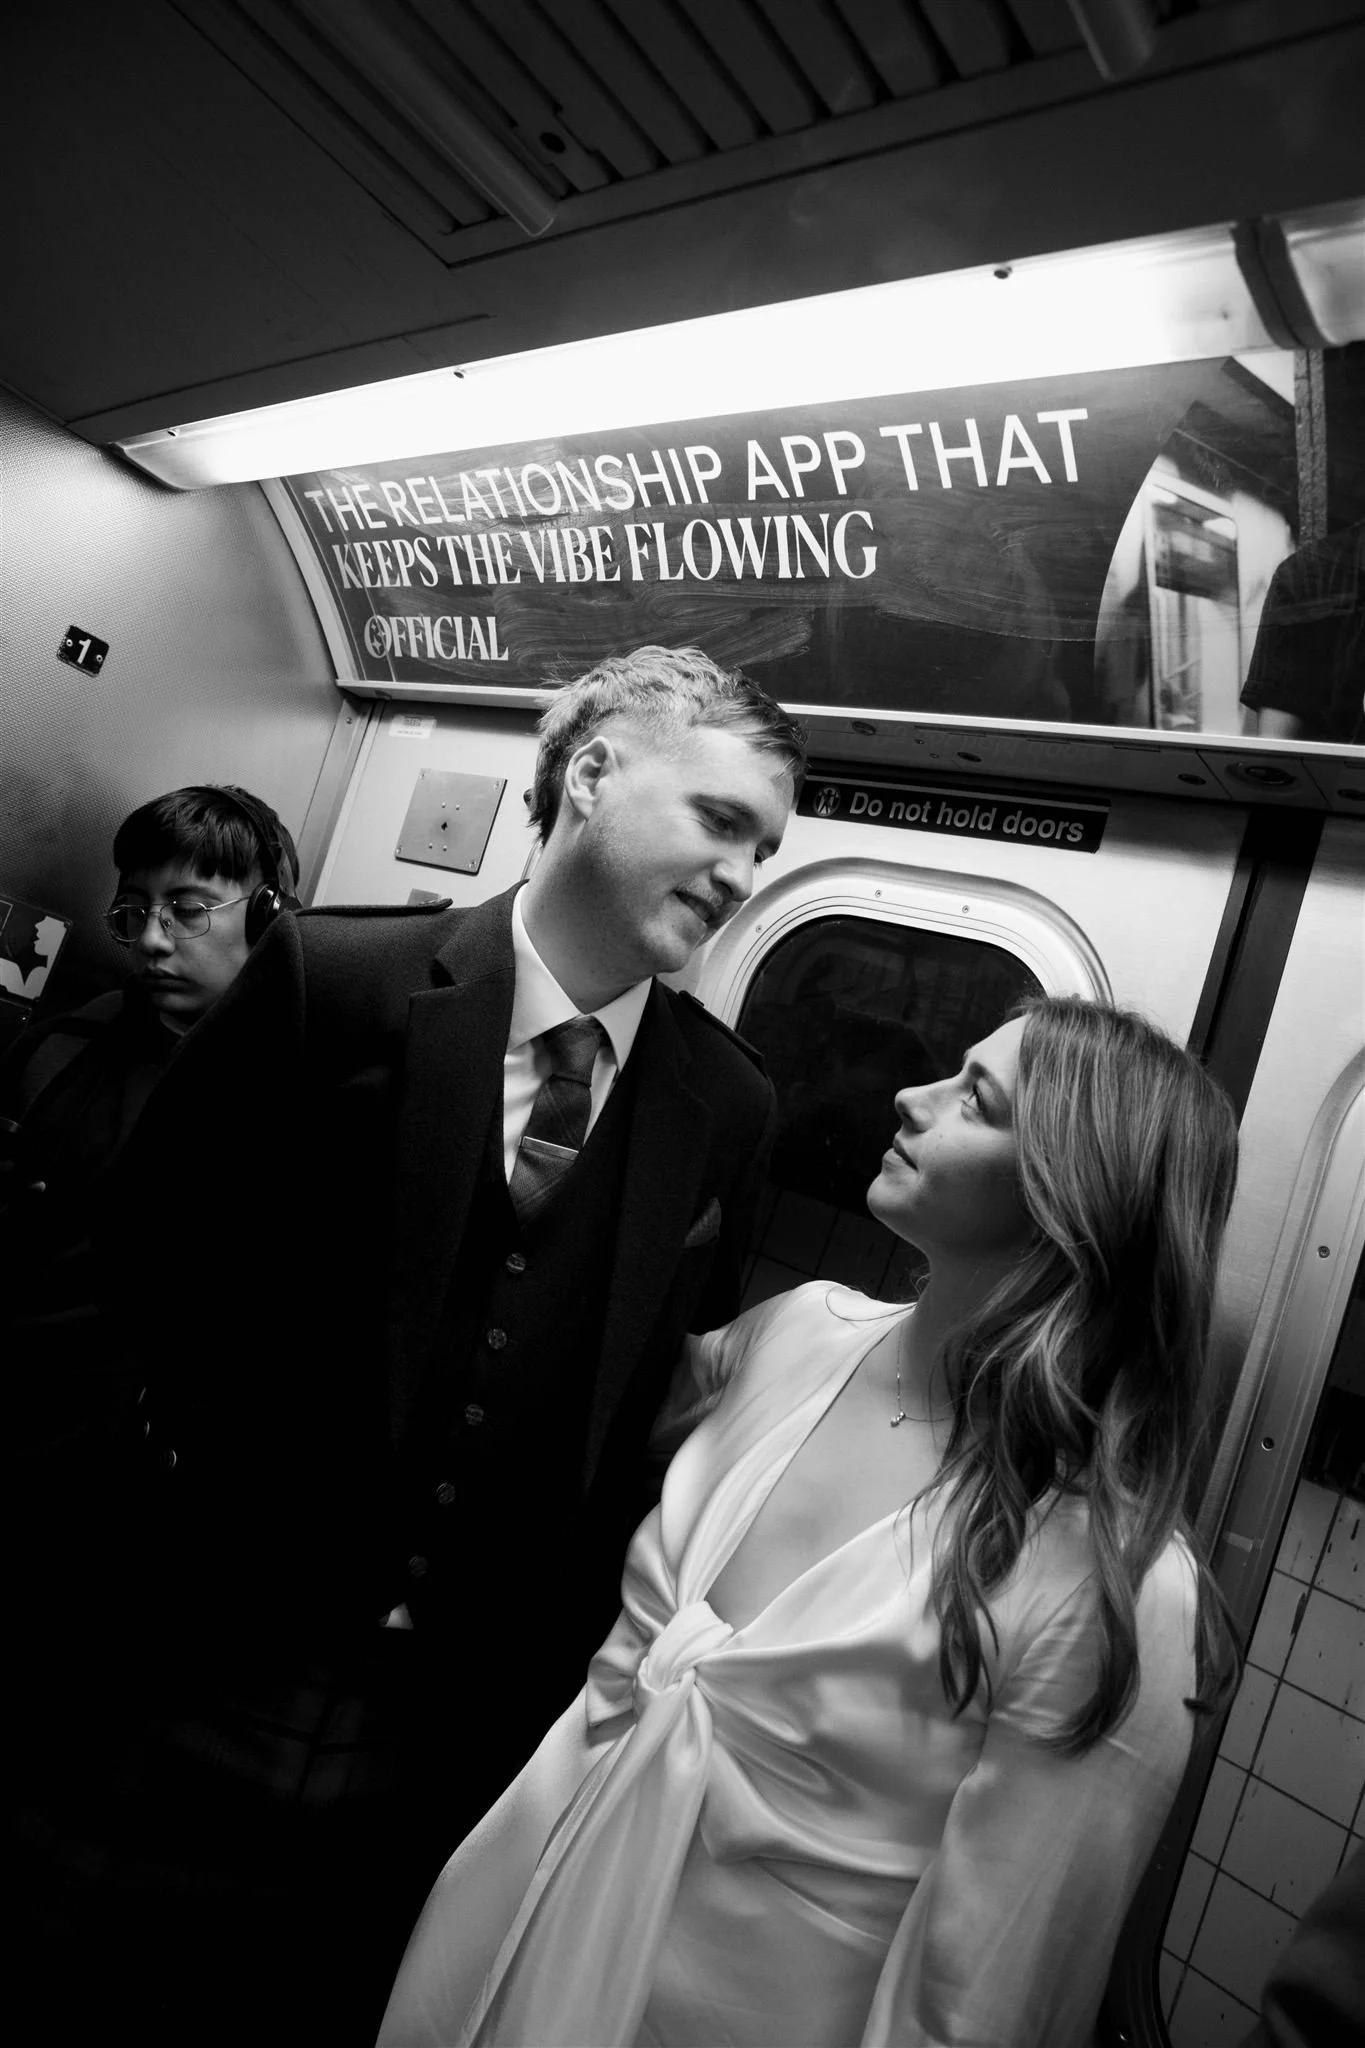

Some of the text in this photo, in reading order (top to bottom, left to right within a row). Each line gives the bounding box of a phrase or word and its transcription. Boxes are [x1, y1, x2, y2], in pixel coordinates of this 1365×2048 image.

[304, 408, 1089, 533] THE RELATIONSHIP APP THAT
[332, 511, 878, 589] KEEPS THE VIBE FLOWING
[77, 639, 92, 664] 1
[364, 615, 509, 661] OFFICIAL
[849, 792, 1085, 843] Do not hold doors
